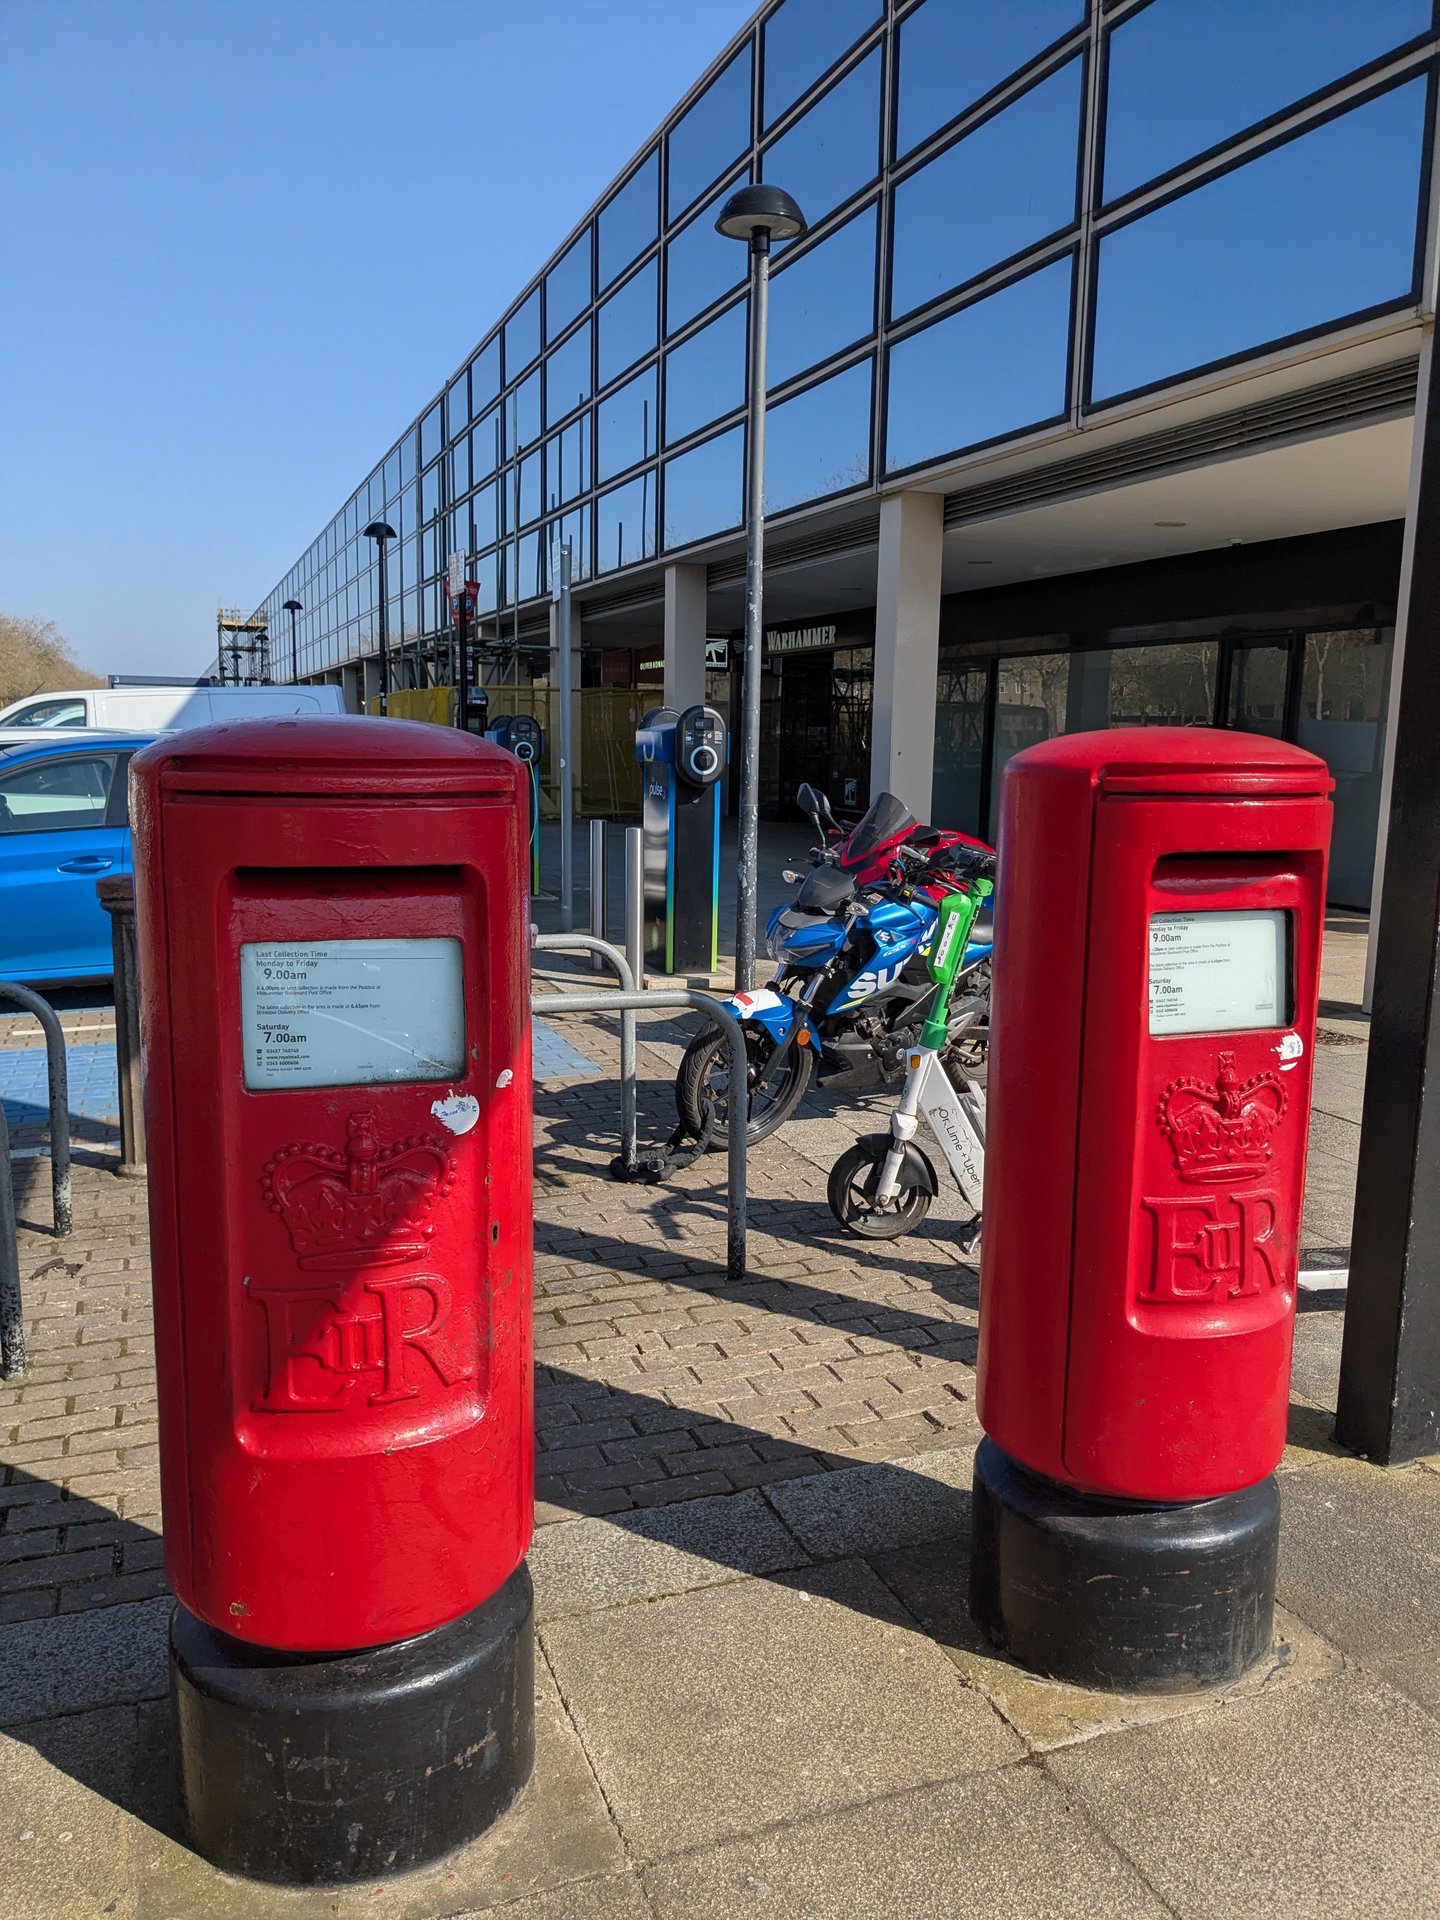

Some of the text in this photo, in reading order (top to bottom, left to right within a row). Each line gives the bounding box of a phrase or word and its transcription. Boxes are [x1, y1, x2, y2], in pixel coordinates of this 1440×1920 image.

[766, 624, 836, 652] WARHAMMER
[649, 782, 663, 798] pulse
[1152, 933, 1182, 943] 9.00am
[264, 968, 307, 980] 9.00am
[1154, 985, 1183, 994] 7.00am
[264, 1032, 307, 1043] 7.00am
[946, 1124, 963, 1151] Lime
[963, 1158, 981, 1185] Uber
